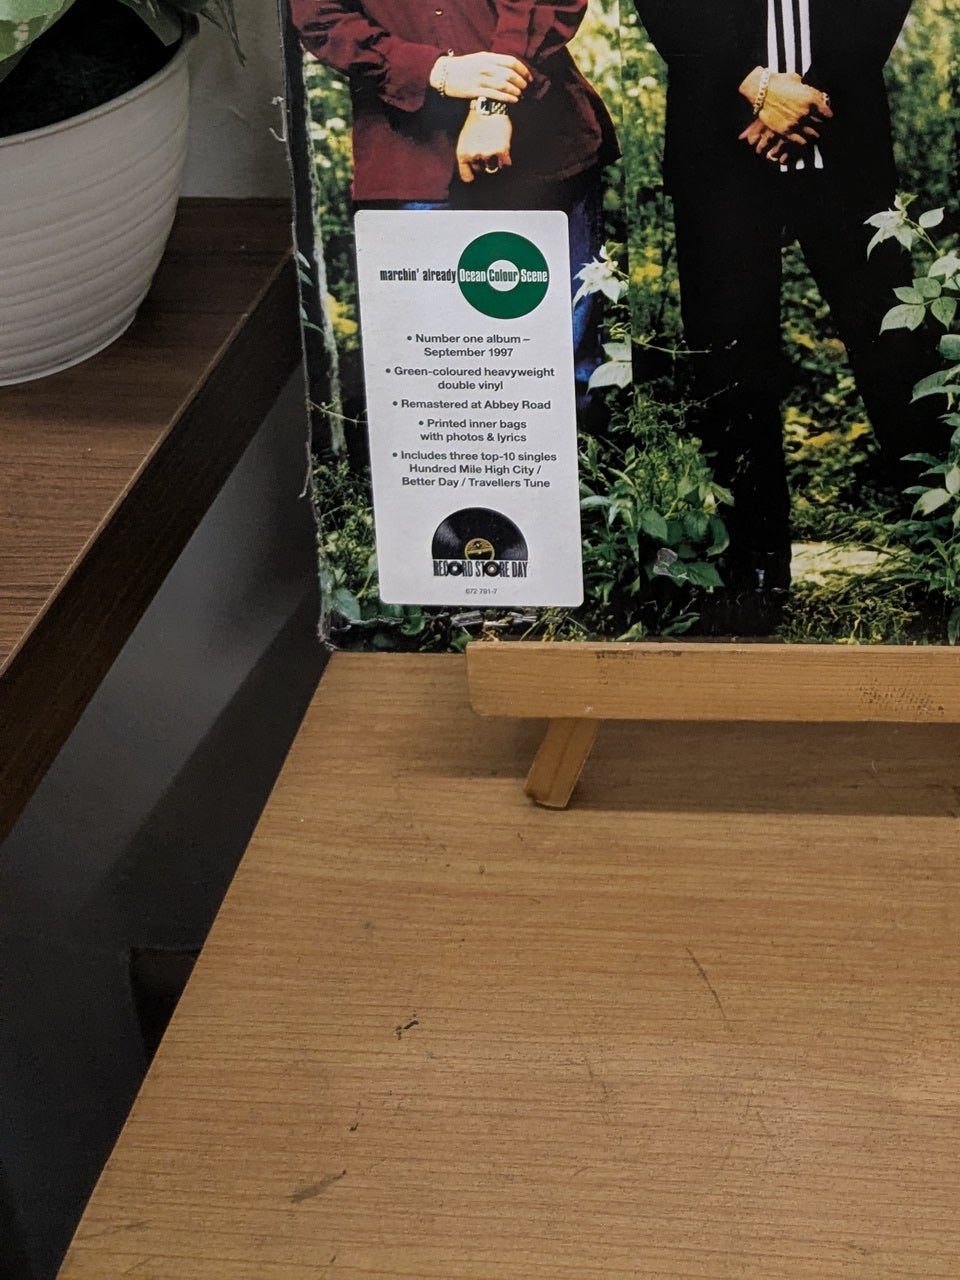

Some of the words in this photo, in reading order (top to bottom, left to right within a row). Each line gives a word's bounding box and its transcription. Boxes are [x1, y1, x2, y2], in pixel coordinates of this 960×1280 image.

[423, 268, 456, 283] already
[459, 268, 487, 282] Ocean
[489, 269, 518, 282] Colour
[520, 268, 548, 282] Scene
[415, 333, 460, 344] Number
[463, 336, 484, 344] one
[486, 334, 521, 344] album
[424, 347, 486, 358] September
[488, 348, 514, 357] 1997
[394, 366, 482, 377] Green-coloured
[484, 367, 555, 379] heavyweight
[437, 380, 476, 390] double
[478, 381, 503, 392] vinyl
[401, 399, 468, 410] Remastered
[471, 401, 482, 410] at
[484, 400, 519, 411] Abbey
[522, 400, 551, 410] Road
[427, 419, 467, 428] Printed
[469, 419, 497, 429] inner
[500, 419, 527, 430] bags
[420, 432, 444, 441] with
[446, 432, 484, 443] photos
[486, 433, 495, 441] &
[497, 433, 527, 443] lyrics
[401, 450, 447, 460] Includes
[449, 451, 479, 460] three
[481, 452, 515, 462] top-10
[518, 452, 557, 463] singles
[409, 463, 457, 473] Hundred
[459, 464, 483, 474] Mile
[484, 464, 510, 475] High
[512, 465, 535, 476] City
[402, 476, 436, 486] Better
[438, 477, 459, 488] Day
[468, 477, 522, 487] Travellers
[523, 478, 551, 488] Tune
[511, 561, 528, 578] DAY
